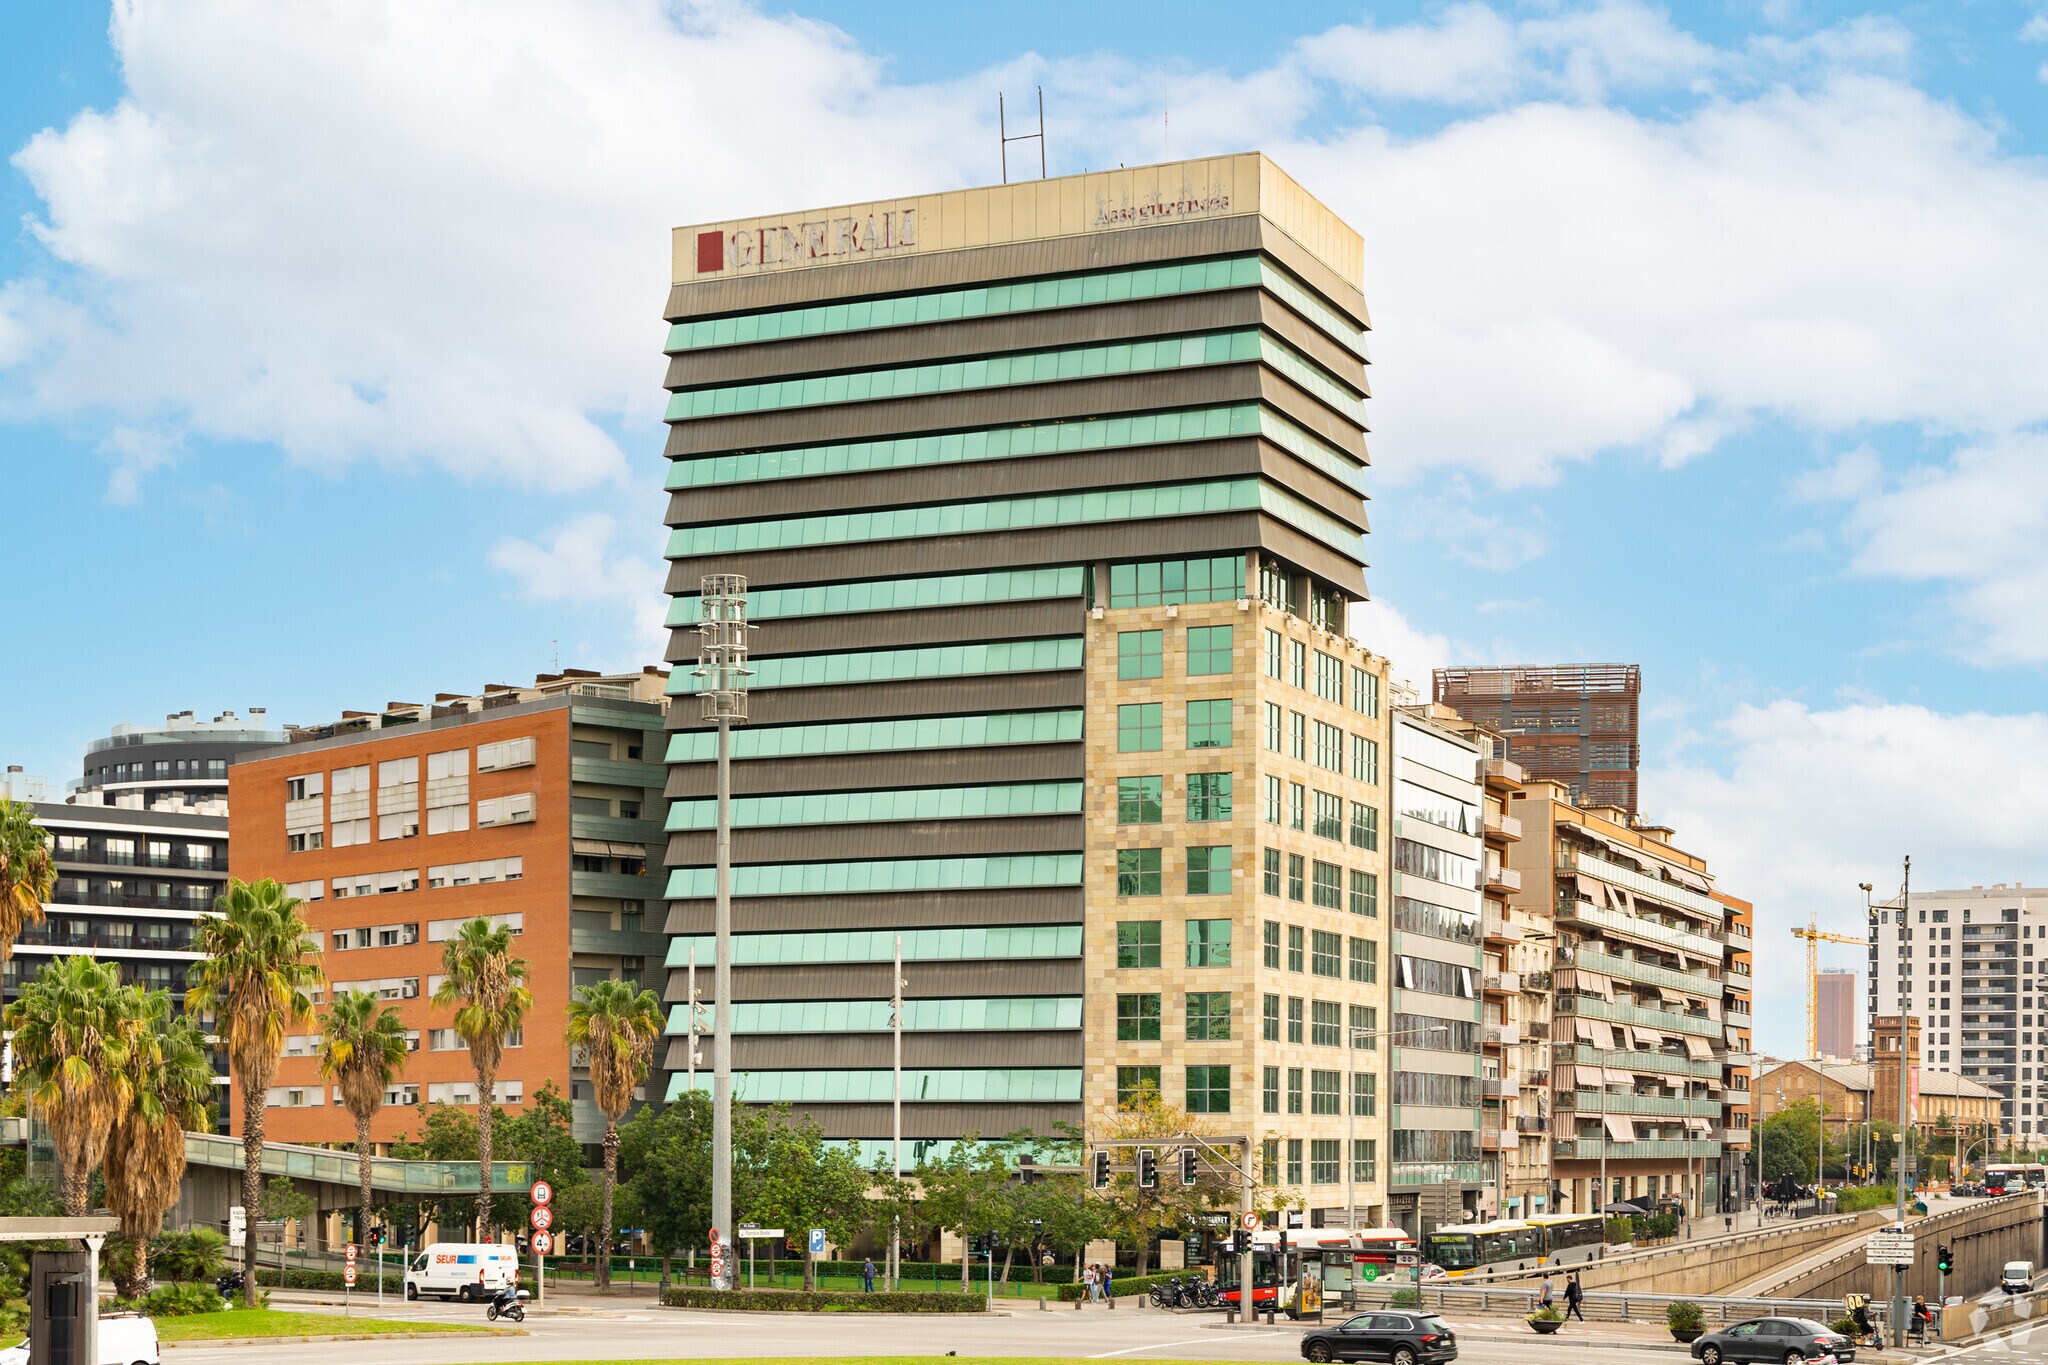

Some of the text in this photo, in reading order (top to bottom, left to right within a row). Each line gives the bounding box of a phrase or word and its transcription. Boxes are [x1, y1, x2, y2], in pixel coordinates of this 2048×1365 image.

[726, 208, 916, 268] GENERALI
[812, 1231, 823, 1244] P
[435, 1254, 457, 1264] SEUR
[1365, 1268, 1376, 1276] V3
